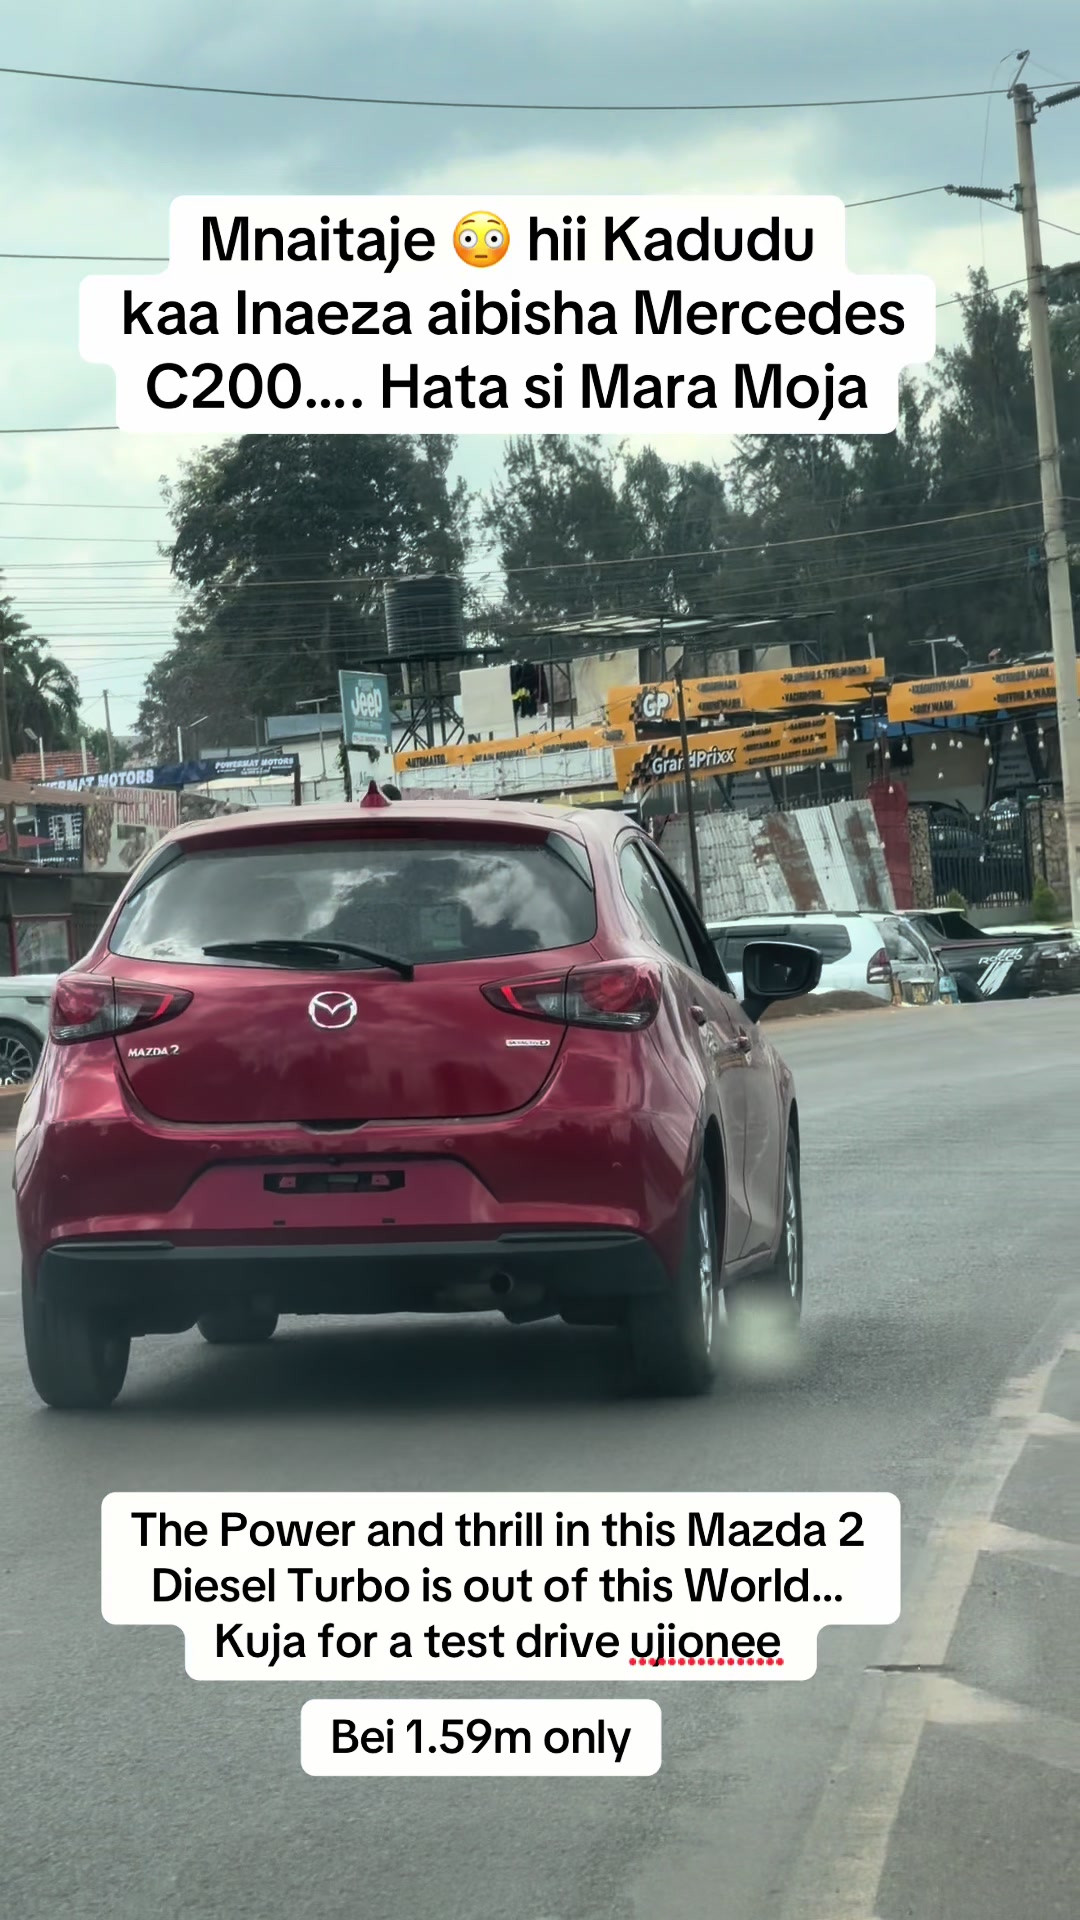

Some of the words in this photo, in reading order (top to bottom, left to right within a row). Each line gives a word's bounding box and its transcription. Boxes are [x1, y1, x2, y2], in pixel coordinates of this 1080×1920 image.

[351, 686, 382, 718] Jeep
[642, 692, 670, 718] GP
[215, 759, 259, 770] POWERMAT
[261, 757, 294, 767] MOTORS
[98, 769, 155, 788] MOTORS
[978, 954, 1024, 965] ROCCO
[127, 1047, 169, 1058] MAZDA
[169, 1044, 180, 1056] 2
